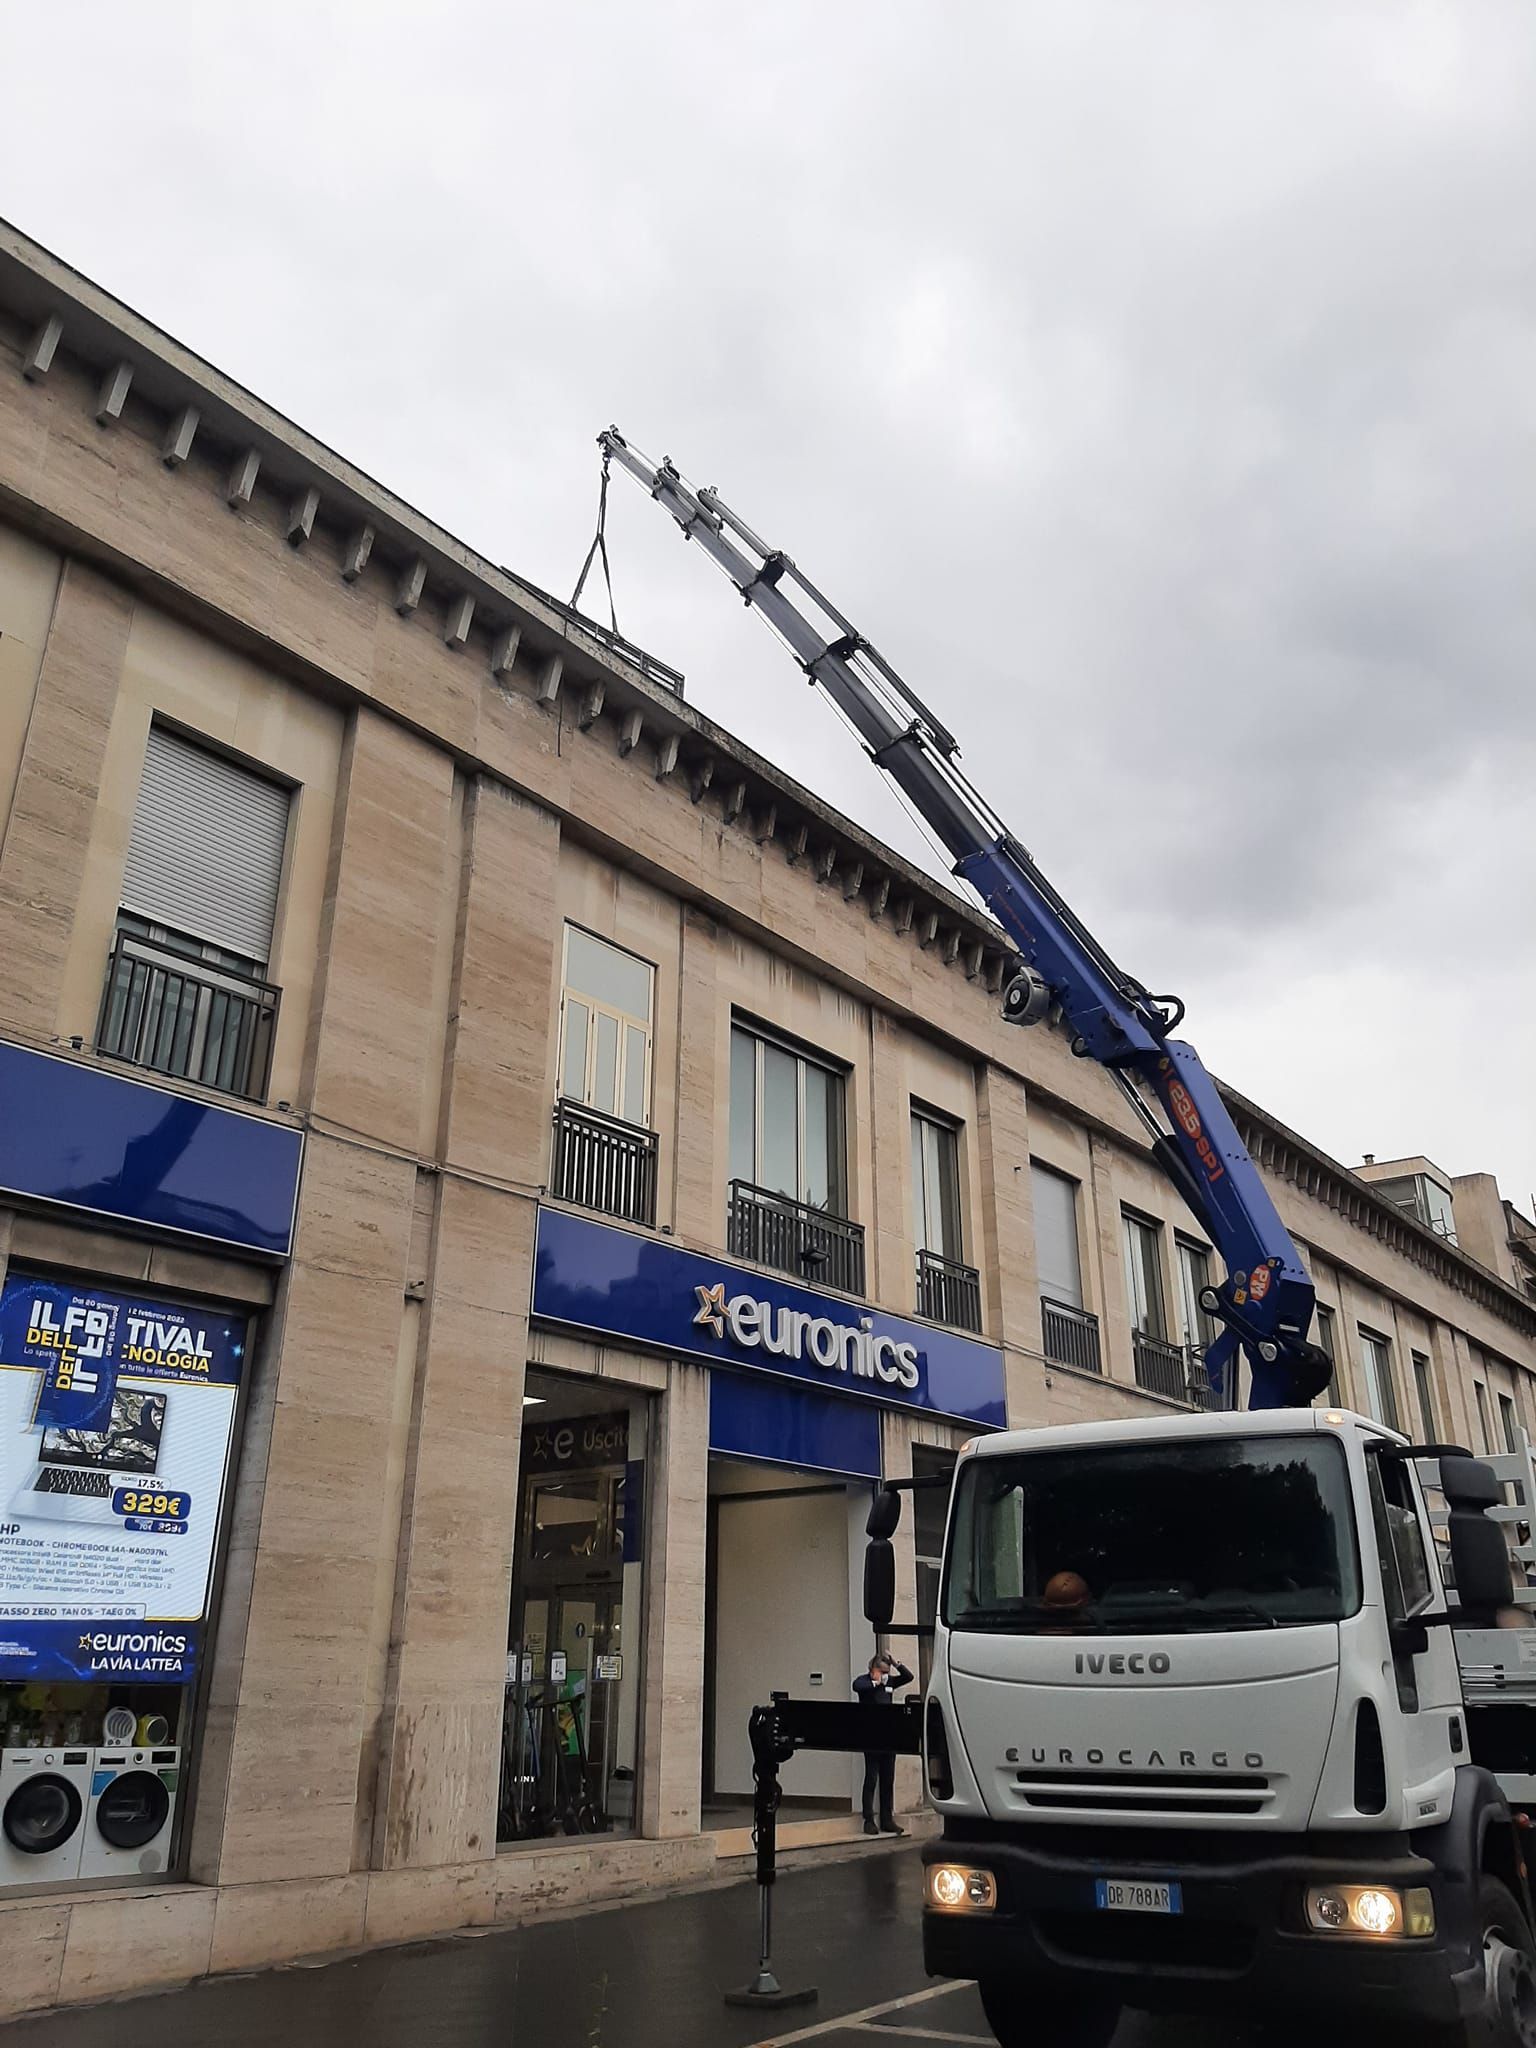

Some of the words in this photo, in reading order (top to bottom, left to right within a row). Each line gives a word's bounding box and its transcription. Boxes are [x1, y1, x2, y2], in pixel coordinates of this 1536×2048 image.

[167, 1314, 185, 1323] 2022
[127, 1317, 213, 1358] TIVAL
[727, 1294, 919, 1389] euronics
[121, 1344, 209, 1372] NOLOGIA
[179, 1371, 208, 1382] Euronics
[137, 1479, 164, 1490] 17.5%
[123, 1492, 181, 1516] 329€
[0, 1523, 20, 1535] HP
[52, 1541, 109, 1552] CHROMEBOOK
[0, 1607, 30, 1616] TASSO
[31, 1607, 57, 1616] ZERO
[61, 1608, 80, 1616] TAN
[81, 1608, 94, 1616] 0%
[101, 1608, 123, 1616] TAEG
[125, 1608, 137, 1616] 0%
[93, 1630, 186, 1654] euronics
[134, 1657, 183, 1671] LATTEA
[1074, 1652, 1171, 1675] IVECO
[1005, 1747, 1264, 1768] EUROCARGO
[1108, 1885, 1124, 1904] DB
[1127, 1886, 1169, 1907] 788AR
